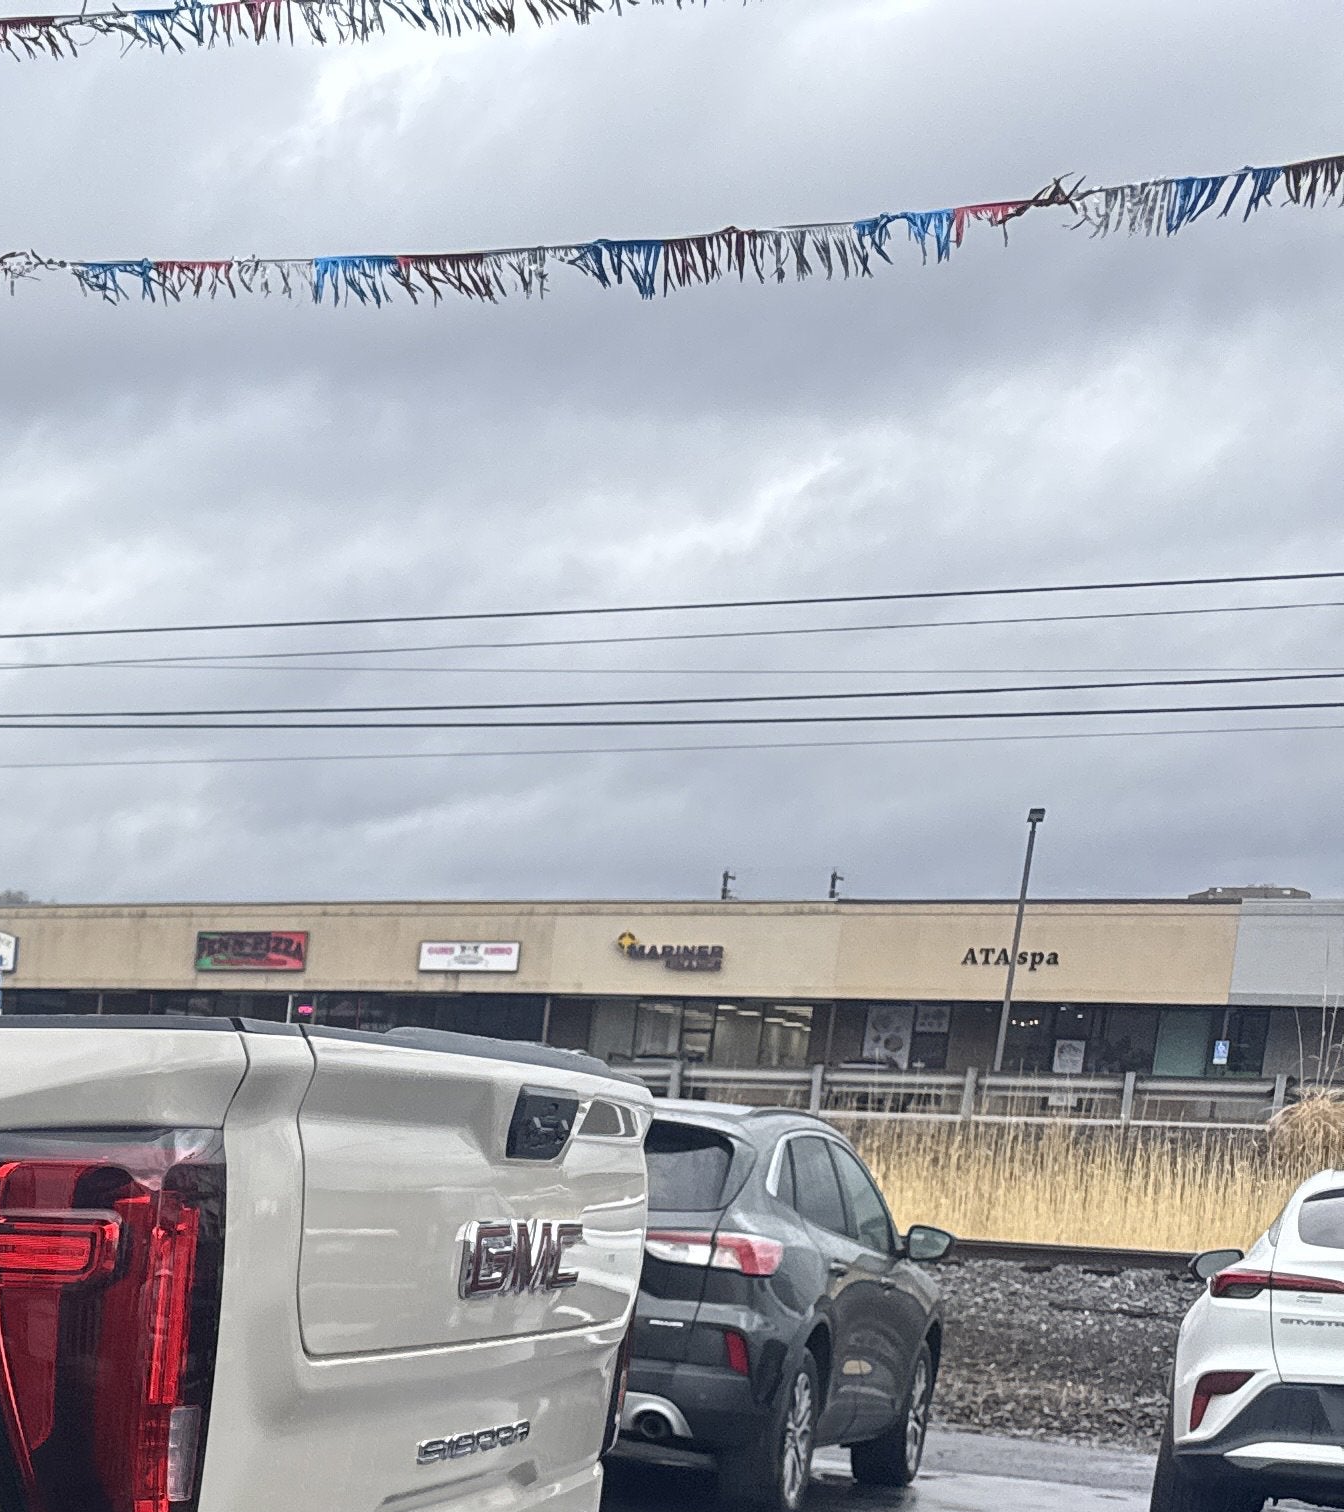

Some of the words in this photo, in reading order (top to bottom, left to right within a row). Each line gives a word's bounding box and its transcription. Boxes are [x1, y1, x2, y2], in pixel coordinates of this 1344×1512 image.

[627, 944, 723, 960] MARINER
[960, 947, 1012, 966] ATA
[1016, 951, 1059, 972] spa
[455, 1217, 584, 1300] GMC
[415, 1418, 531, 1465] SIERRA
